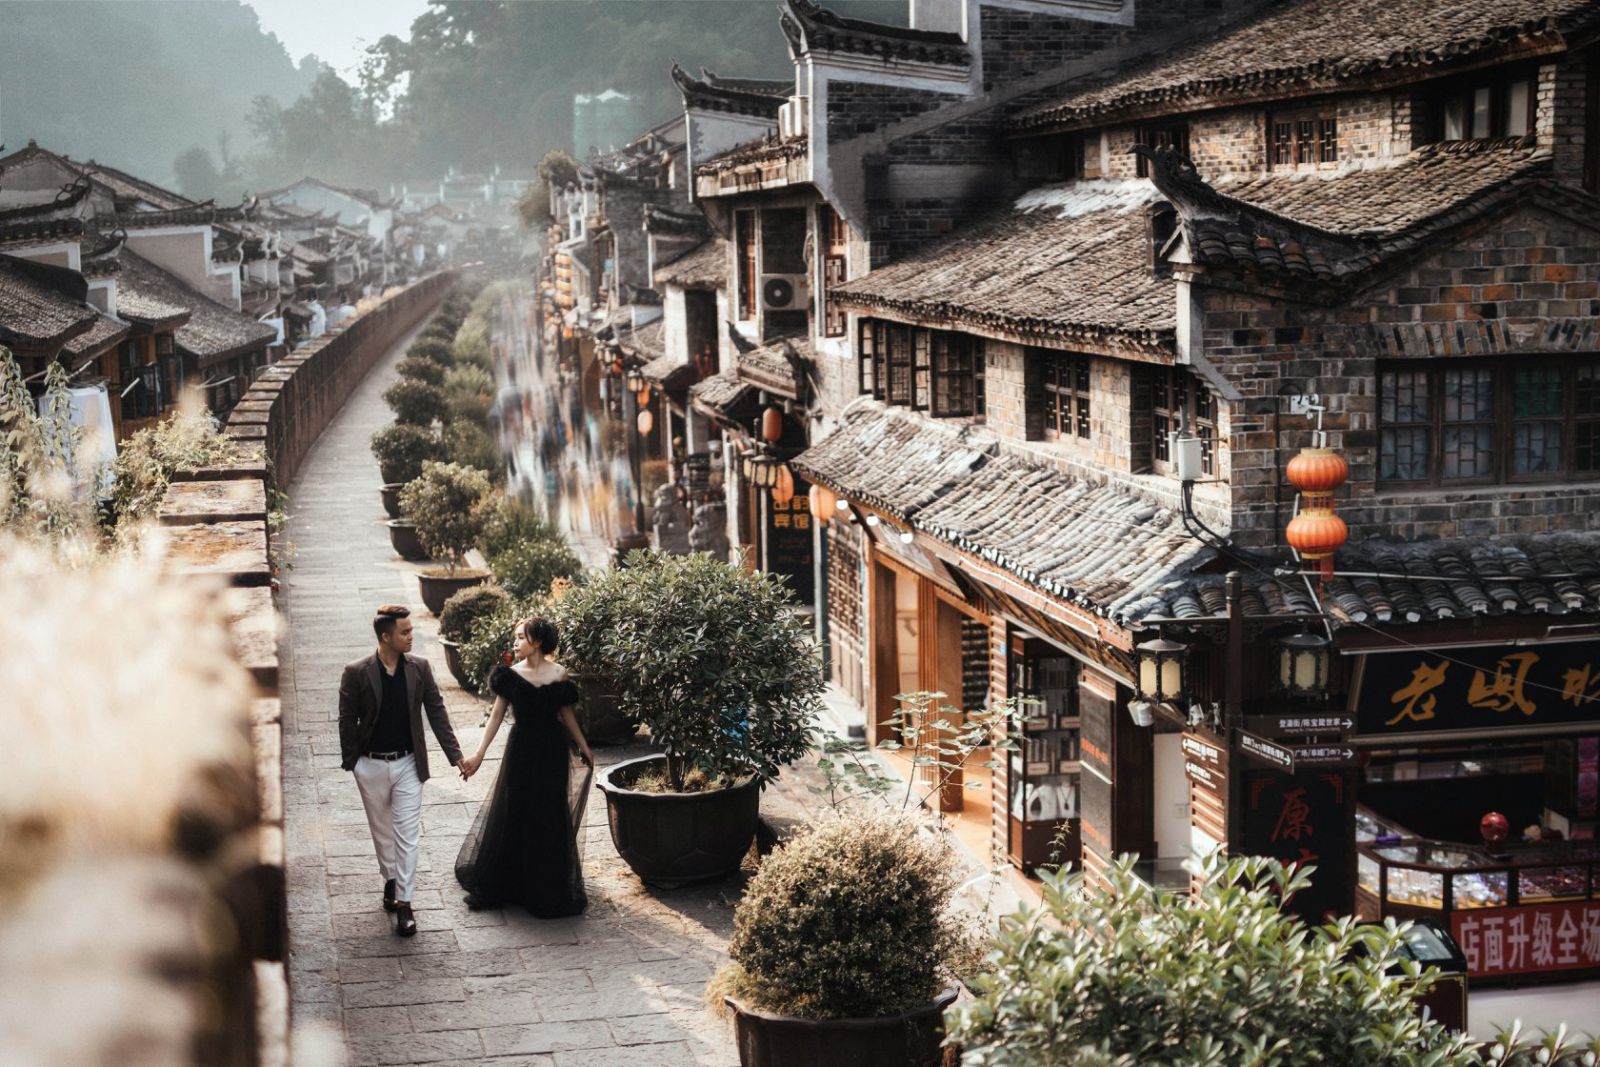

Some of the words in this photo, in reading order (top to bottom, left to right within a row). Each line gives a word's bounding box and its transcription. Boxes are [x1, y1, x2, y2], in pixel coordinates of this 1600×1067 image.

[773, 513, 809, 528] 宾馆
[1459, 907, 1600, 972] 店面升级全场
